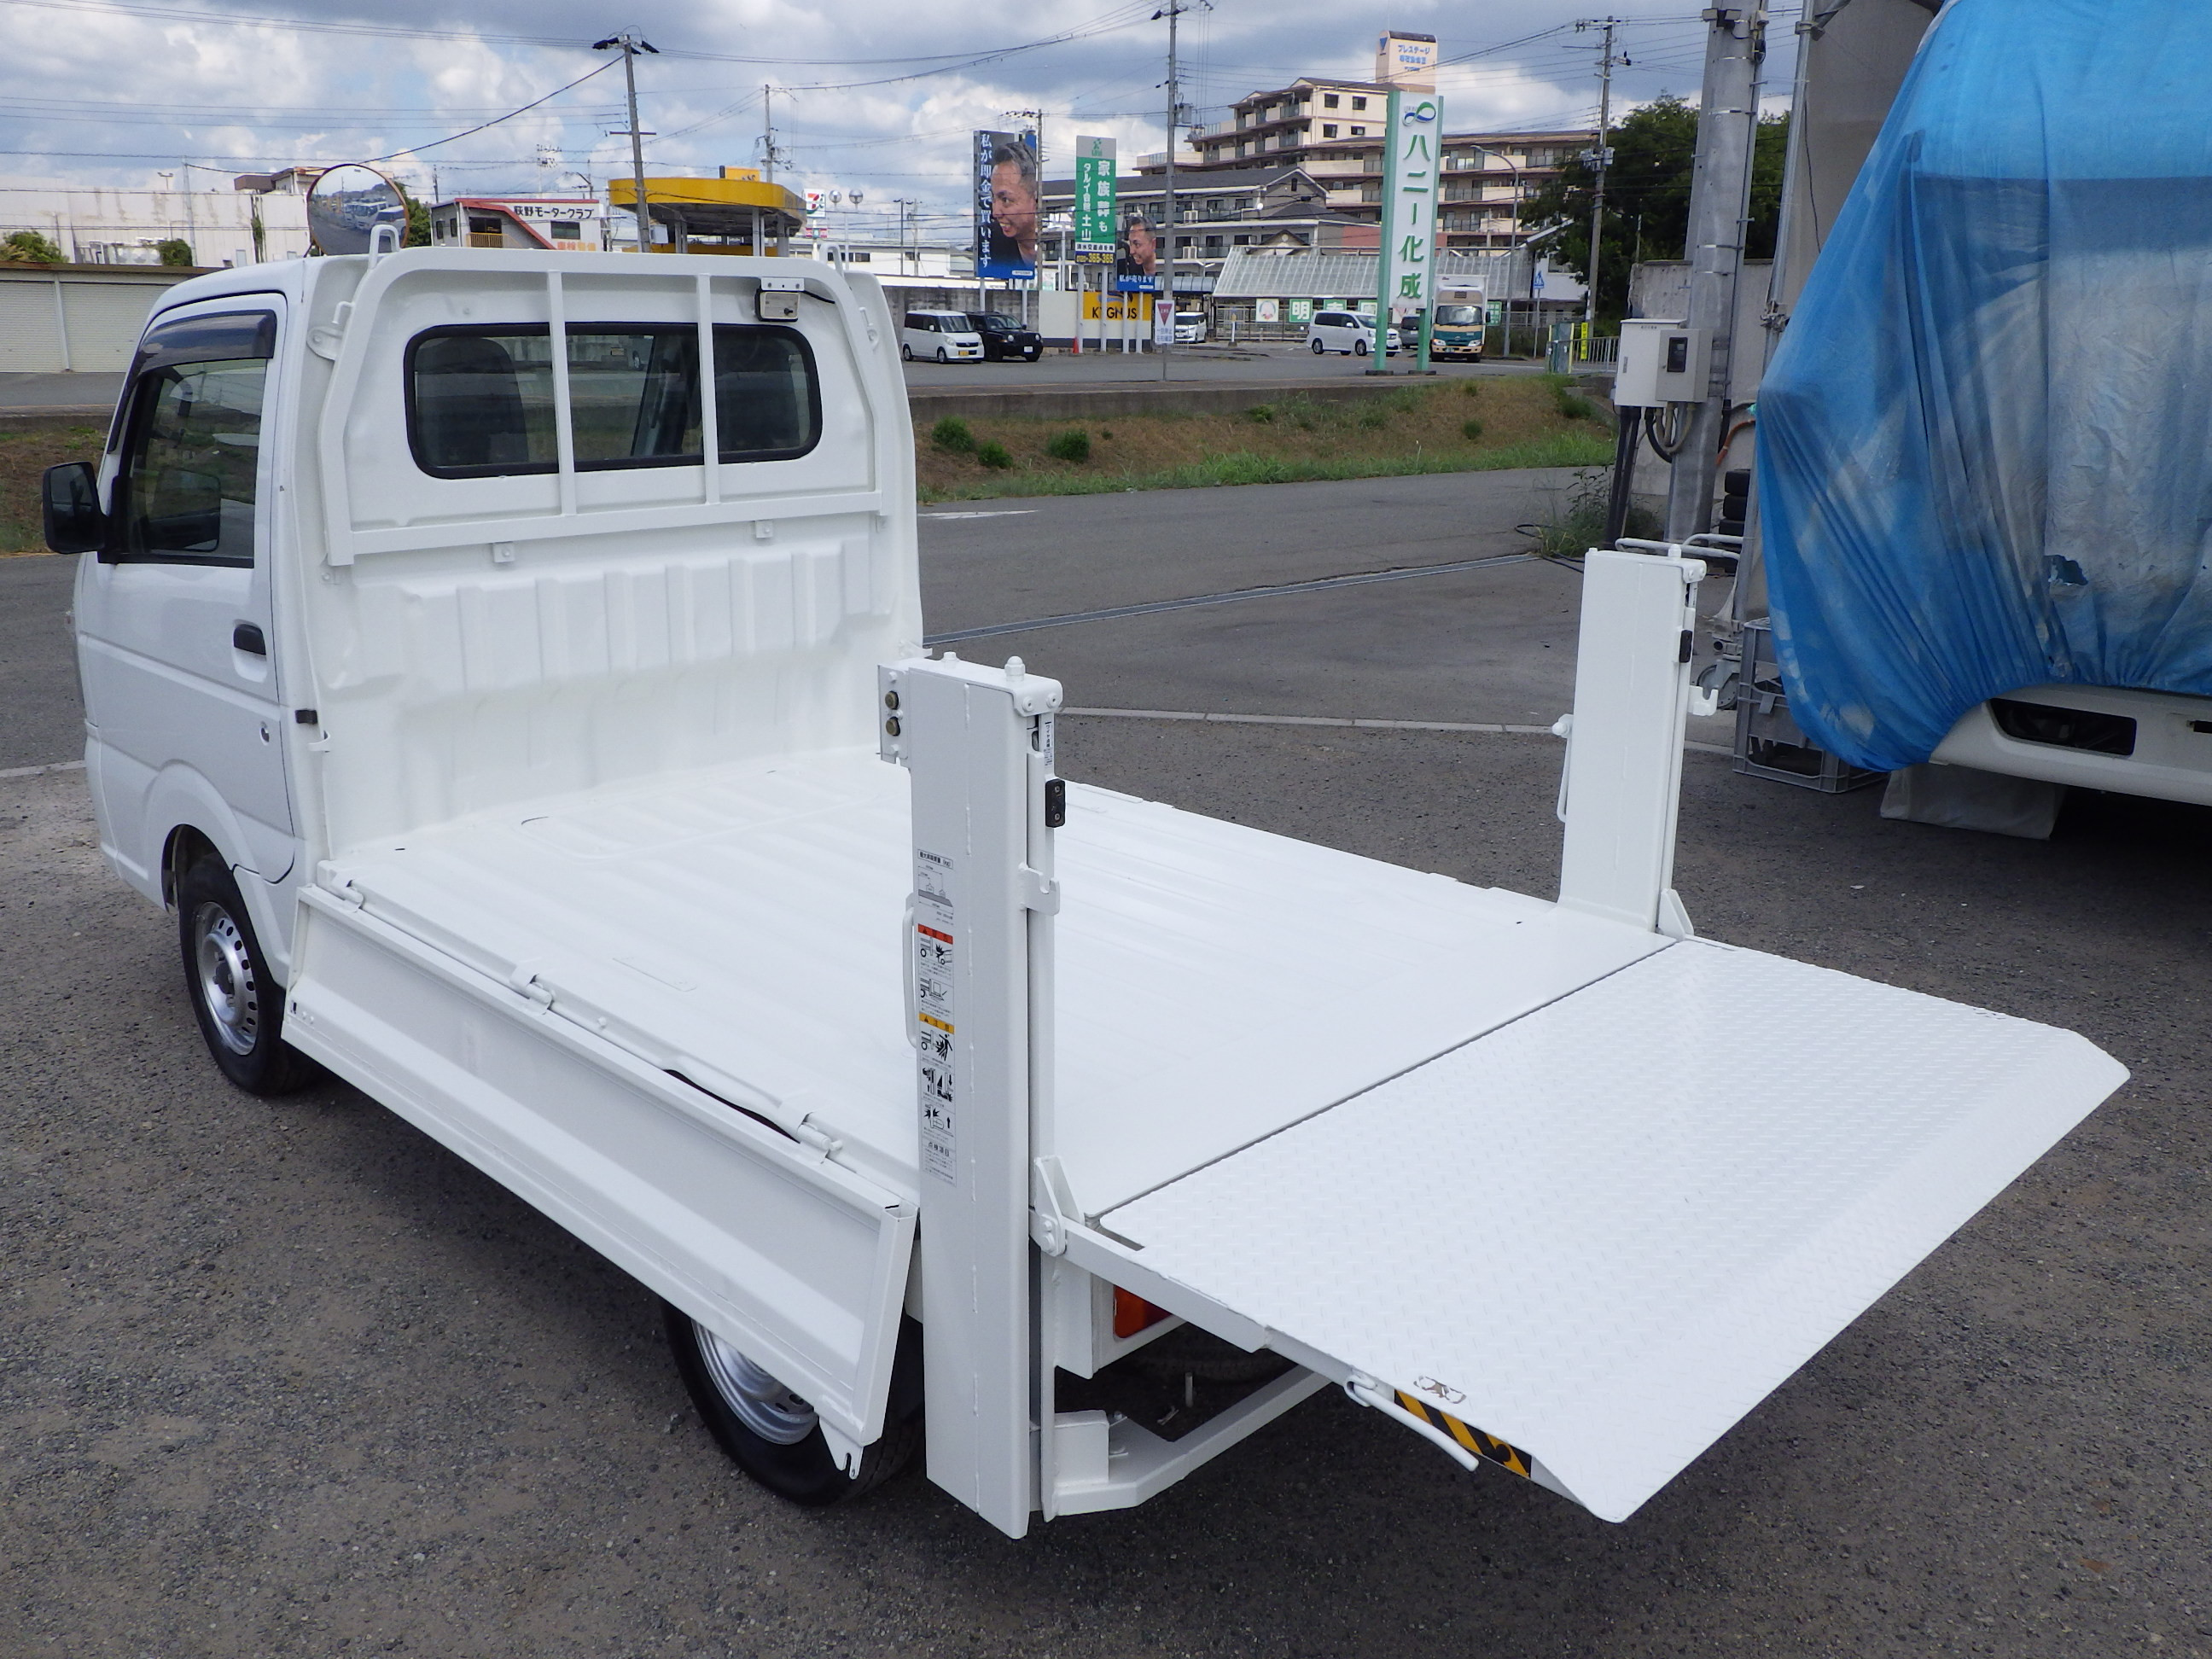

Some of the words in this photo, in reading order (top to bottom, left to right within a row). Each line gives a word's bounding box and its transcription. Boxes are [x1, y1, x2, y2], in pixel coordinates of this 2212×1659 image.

[981, 133, 992, 268] 私が即金で買います
[1097, 160, 1110, 232] 家族葬も
[1397, 134, 1431, 300] ハニー化成
